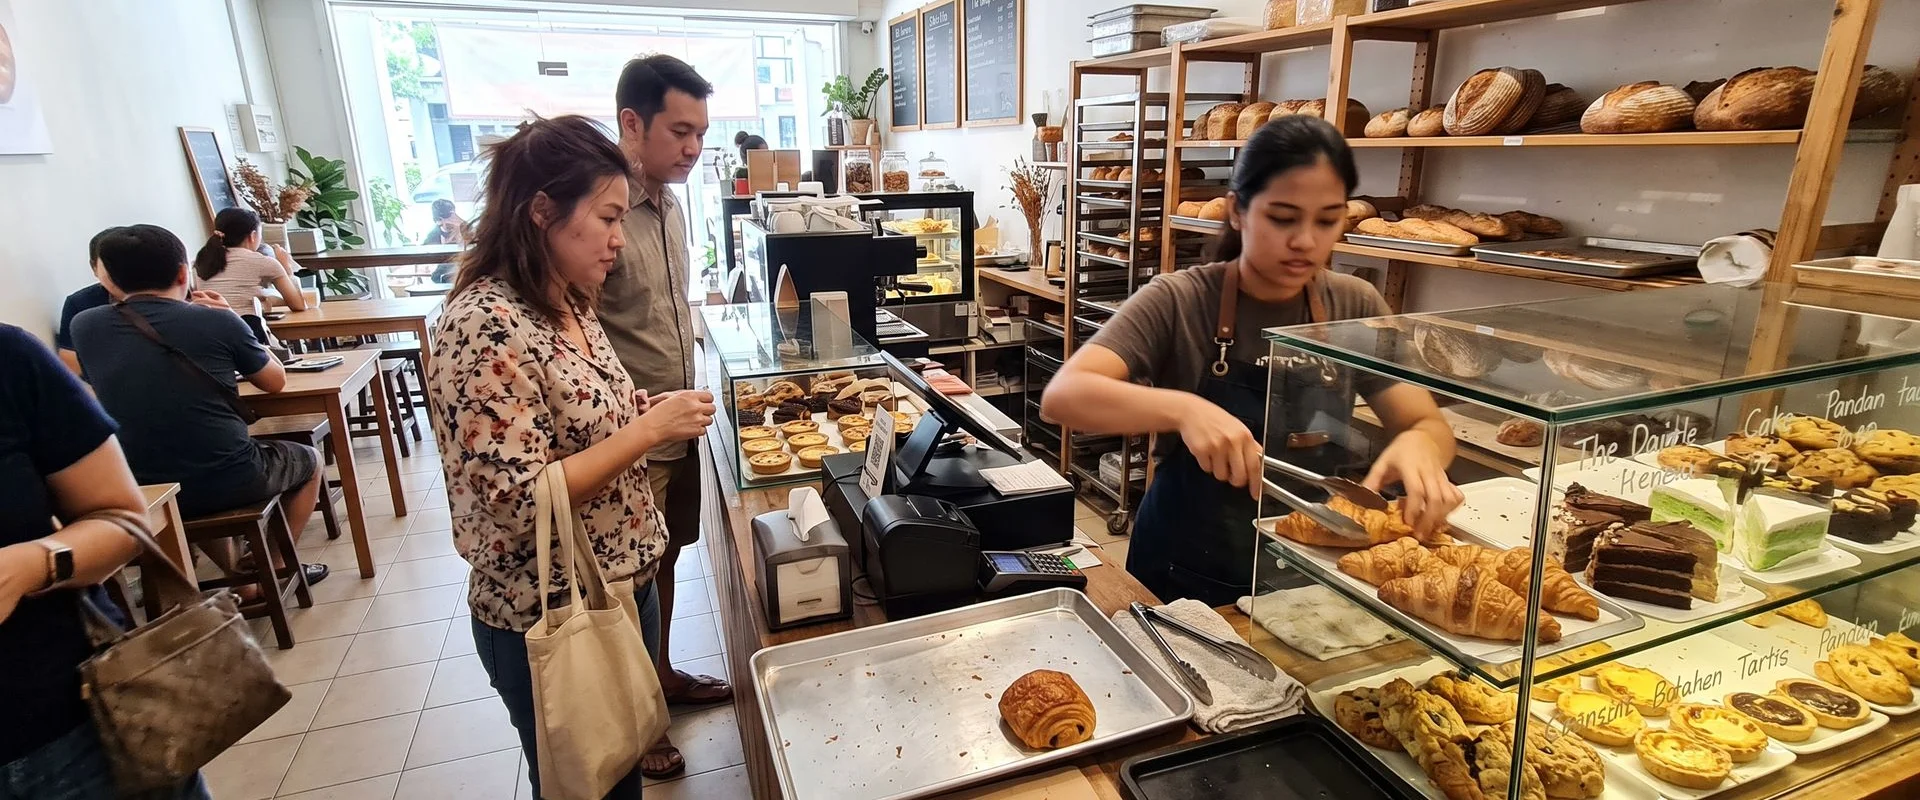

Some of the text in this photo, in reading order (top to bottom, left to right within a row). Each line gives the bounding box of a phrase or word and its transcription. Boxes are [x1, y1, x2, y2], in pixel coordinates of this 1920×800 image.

[1744, 405, 1794, 438] Cake
[1825, 385, 1886, 420] Pandan
[1573, 433, 1619, 471] The
[1818, 616, 1878, 658] Pandan
[1652, 669, 1723, 709] Botahen
[1737, 645, 1789, 680] Tartis
